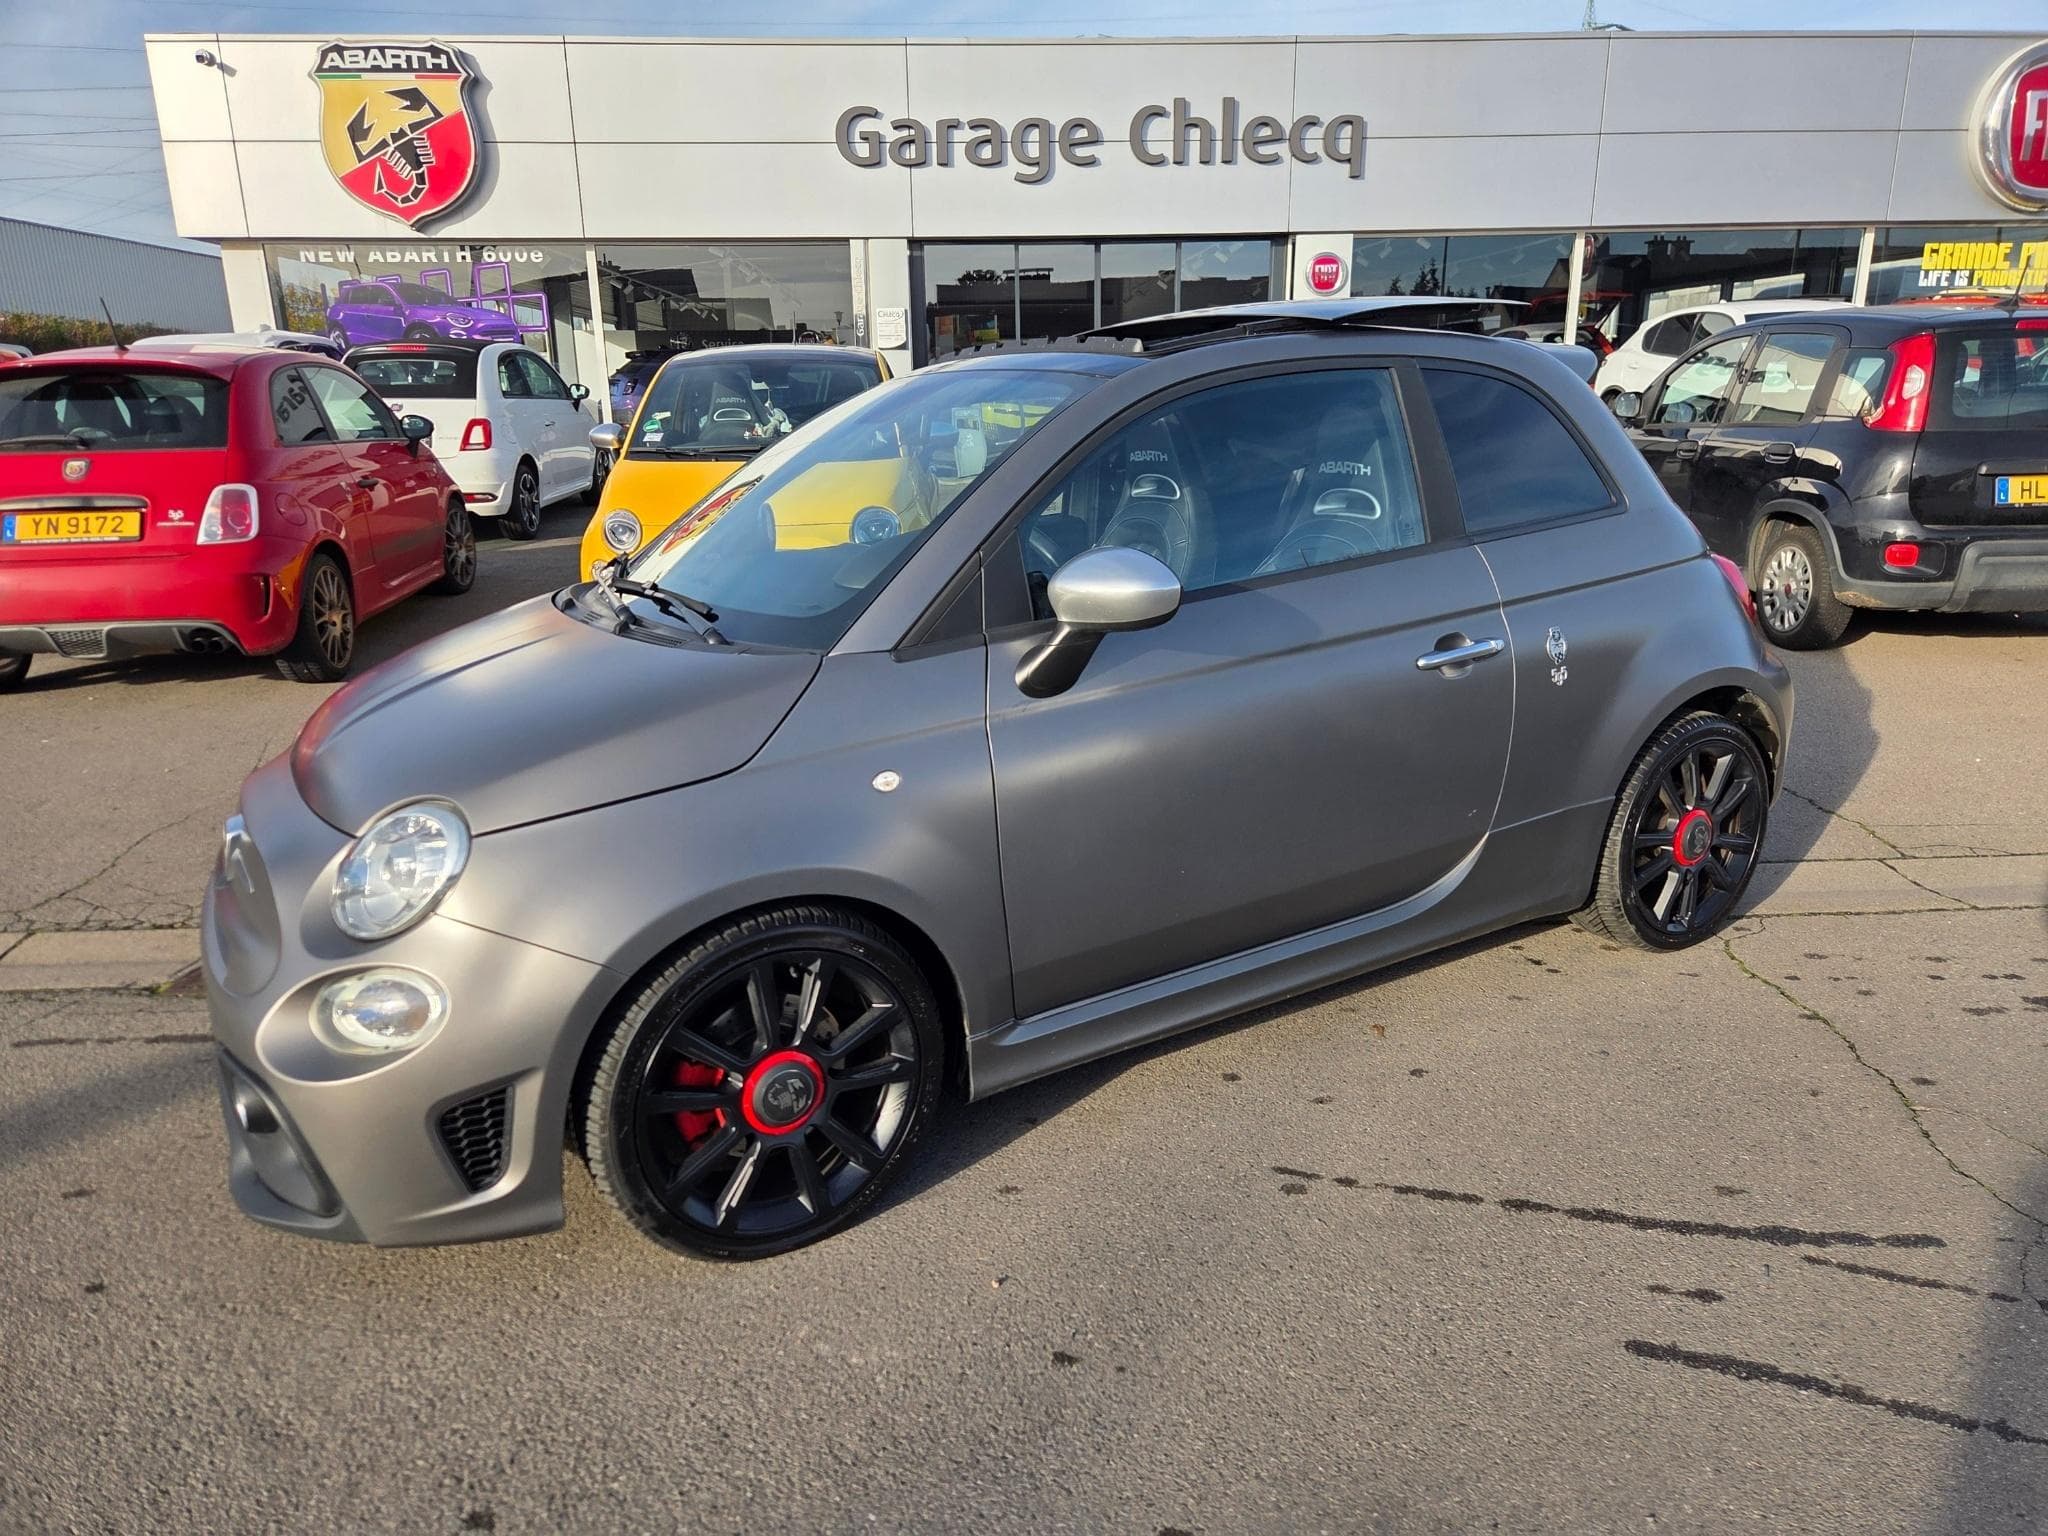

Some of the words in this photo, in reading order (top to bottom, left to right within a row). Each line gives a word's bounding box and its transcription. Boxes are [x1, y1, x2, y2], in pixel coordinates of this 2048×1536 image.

[322, 49, 449, 69] ABARTH
[835, 105, 1101, 184] Garage
[1129, 96, 1365, 179] Chlecq
[299, 246, 355, 262] NEW
[367, 246, 473, 263] ABARTH
[482, 245, 544, 263] 600e
[1921, 242, 2014, 269] GRANDE
[1918, 270, 1952, 287] LIFE
[1954, 270, 1970, 287] IS
[1129, 450, 1169, 462] ABARTH
[1318, 461, 1372, 477] ABARTH
[2020, 481, 2046, 499] HL
[31, 517, 60, 536] YN
[67, 515, 125, 535] 9172
